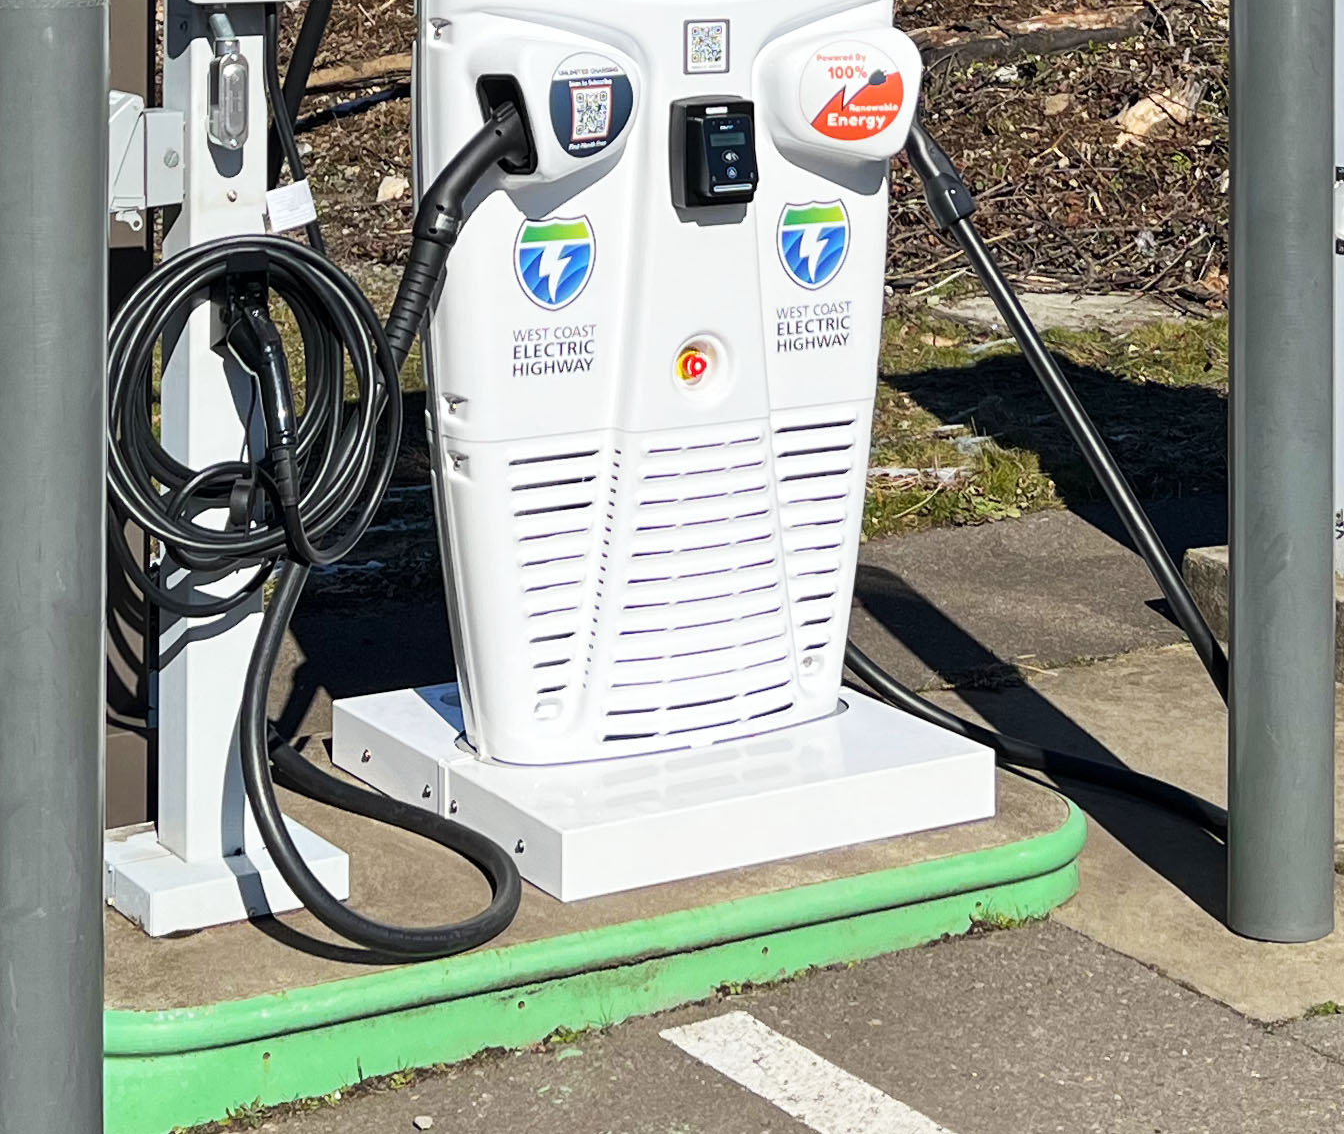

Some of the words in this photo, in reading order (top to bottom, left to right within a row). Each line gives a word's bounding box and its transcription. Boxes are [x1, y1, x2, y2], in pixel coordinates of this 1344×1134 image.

[816, 53, 853, 62] Powered
[855, 53, 866, 63] By
[828, 65, 868, 79] 100%
[849, 103, 899, 112] Renewable
[827, 112, 887, 130] Energy
[776, 305, 809, 320] WEST
[814, 300, 851, 317] COAST
[513, 329, 548, 342] WEST
[554, 324, 597, 340] COAST
[776, 316, 851, 335] ELECTRIC
[513, 339, 595, 358] ELECTRIC
[776, 333, 850, 354] HIGHWAY
[513, 357, 595, 377] HIGHWAY
